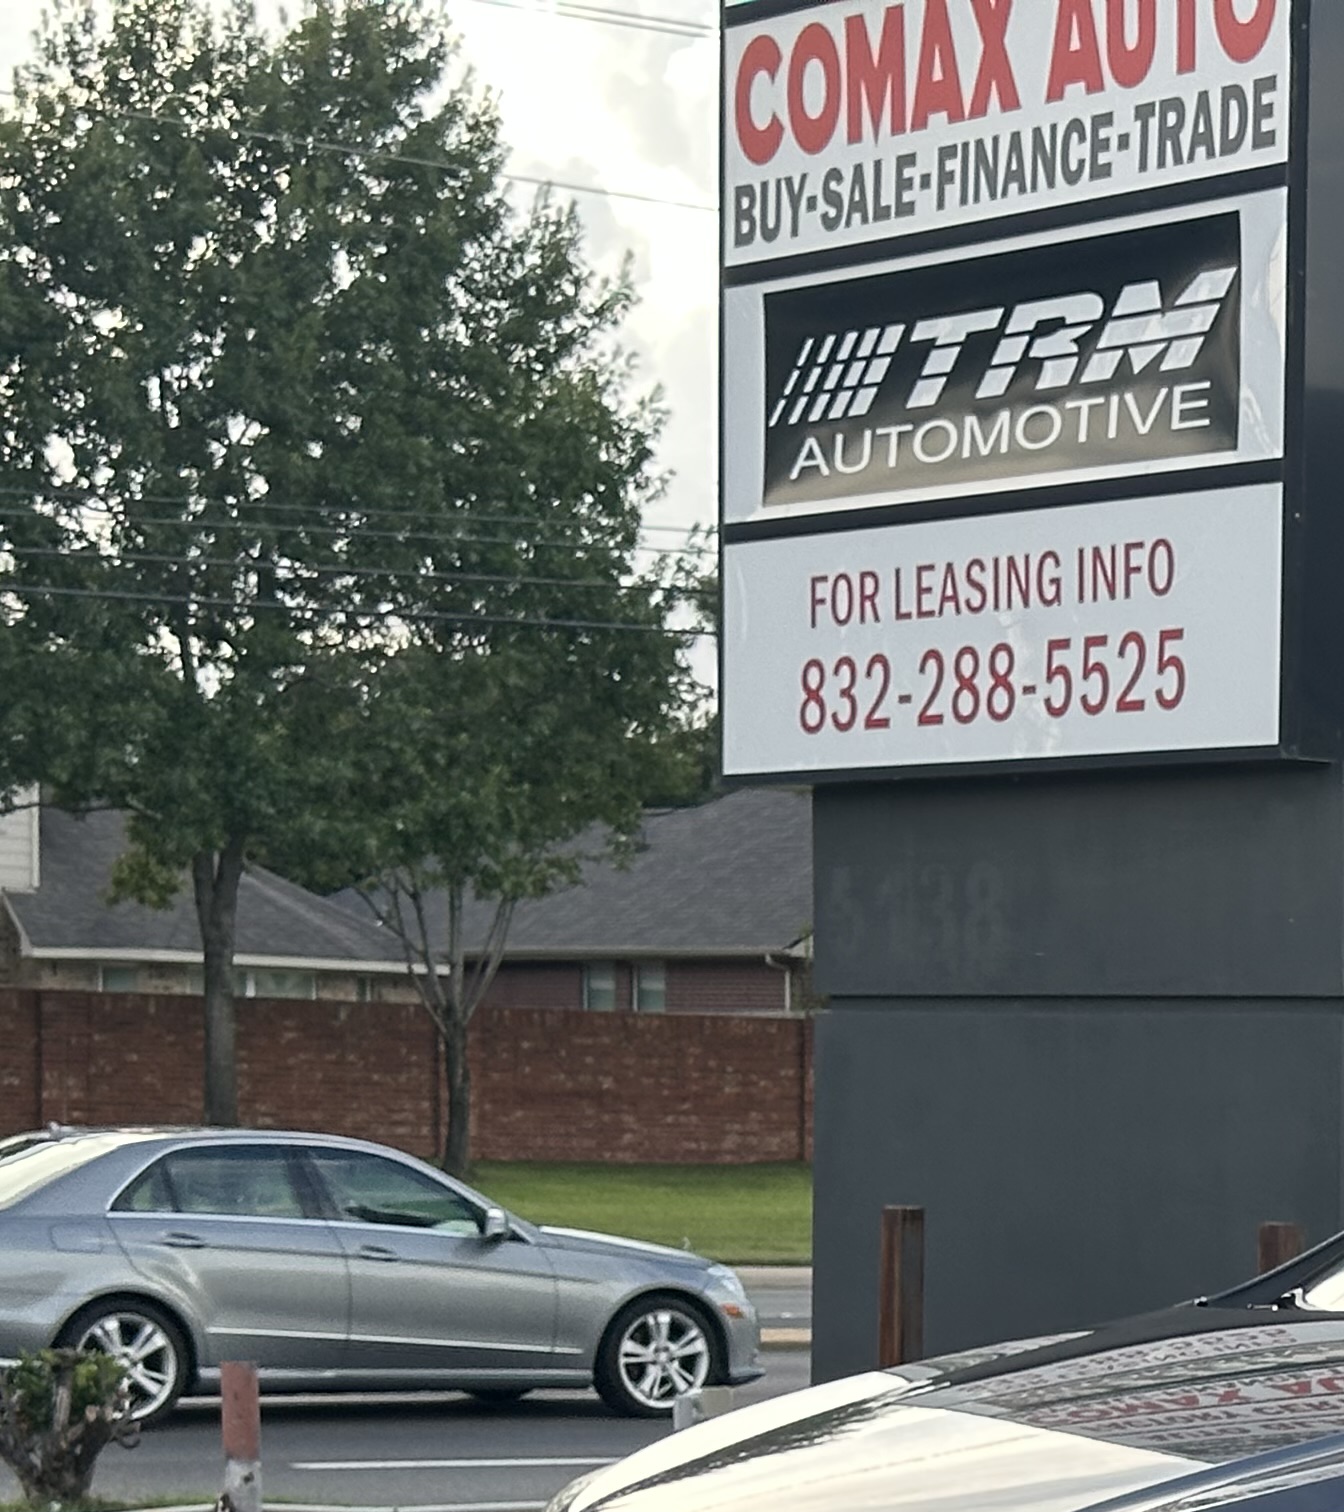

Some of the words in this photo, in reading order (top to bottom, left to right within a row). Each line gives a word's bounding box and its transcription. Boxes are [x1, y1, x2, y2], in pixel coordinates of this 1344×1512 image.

[735, 0, 1021, 166] COMAX
[906, 267, 1237, 409] TRM
[790, 381, 1211, 480] AUTOMOTIVE
[811, 570, 880, 628] FOR
[894, 550, 1062, 620] LEASING
[1077, 538, 1175, 604] INFO
[800, 628, 1186, 735] 832-288-5525
